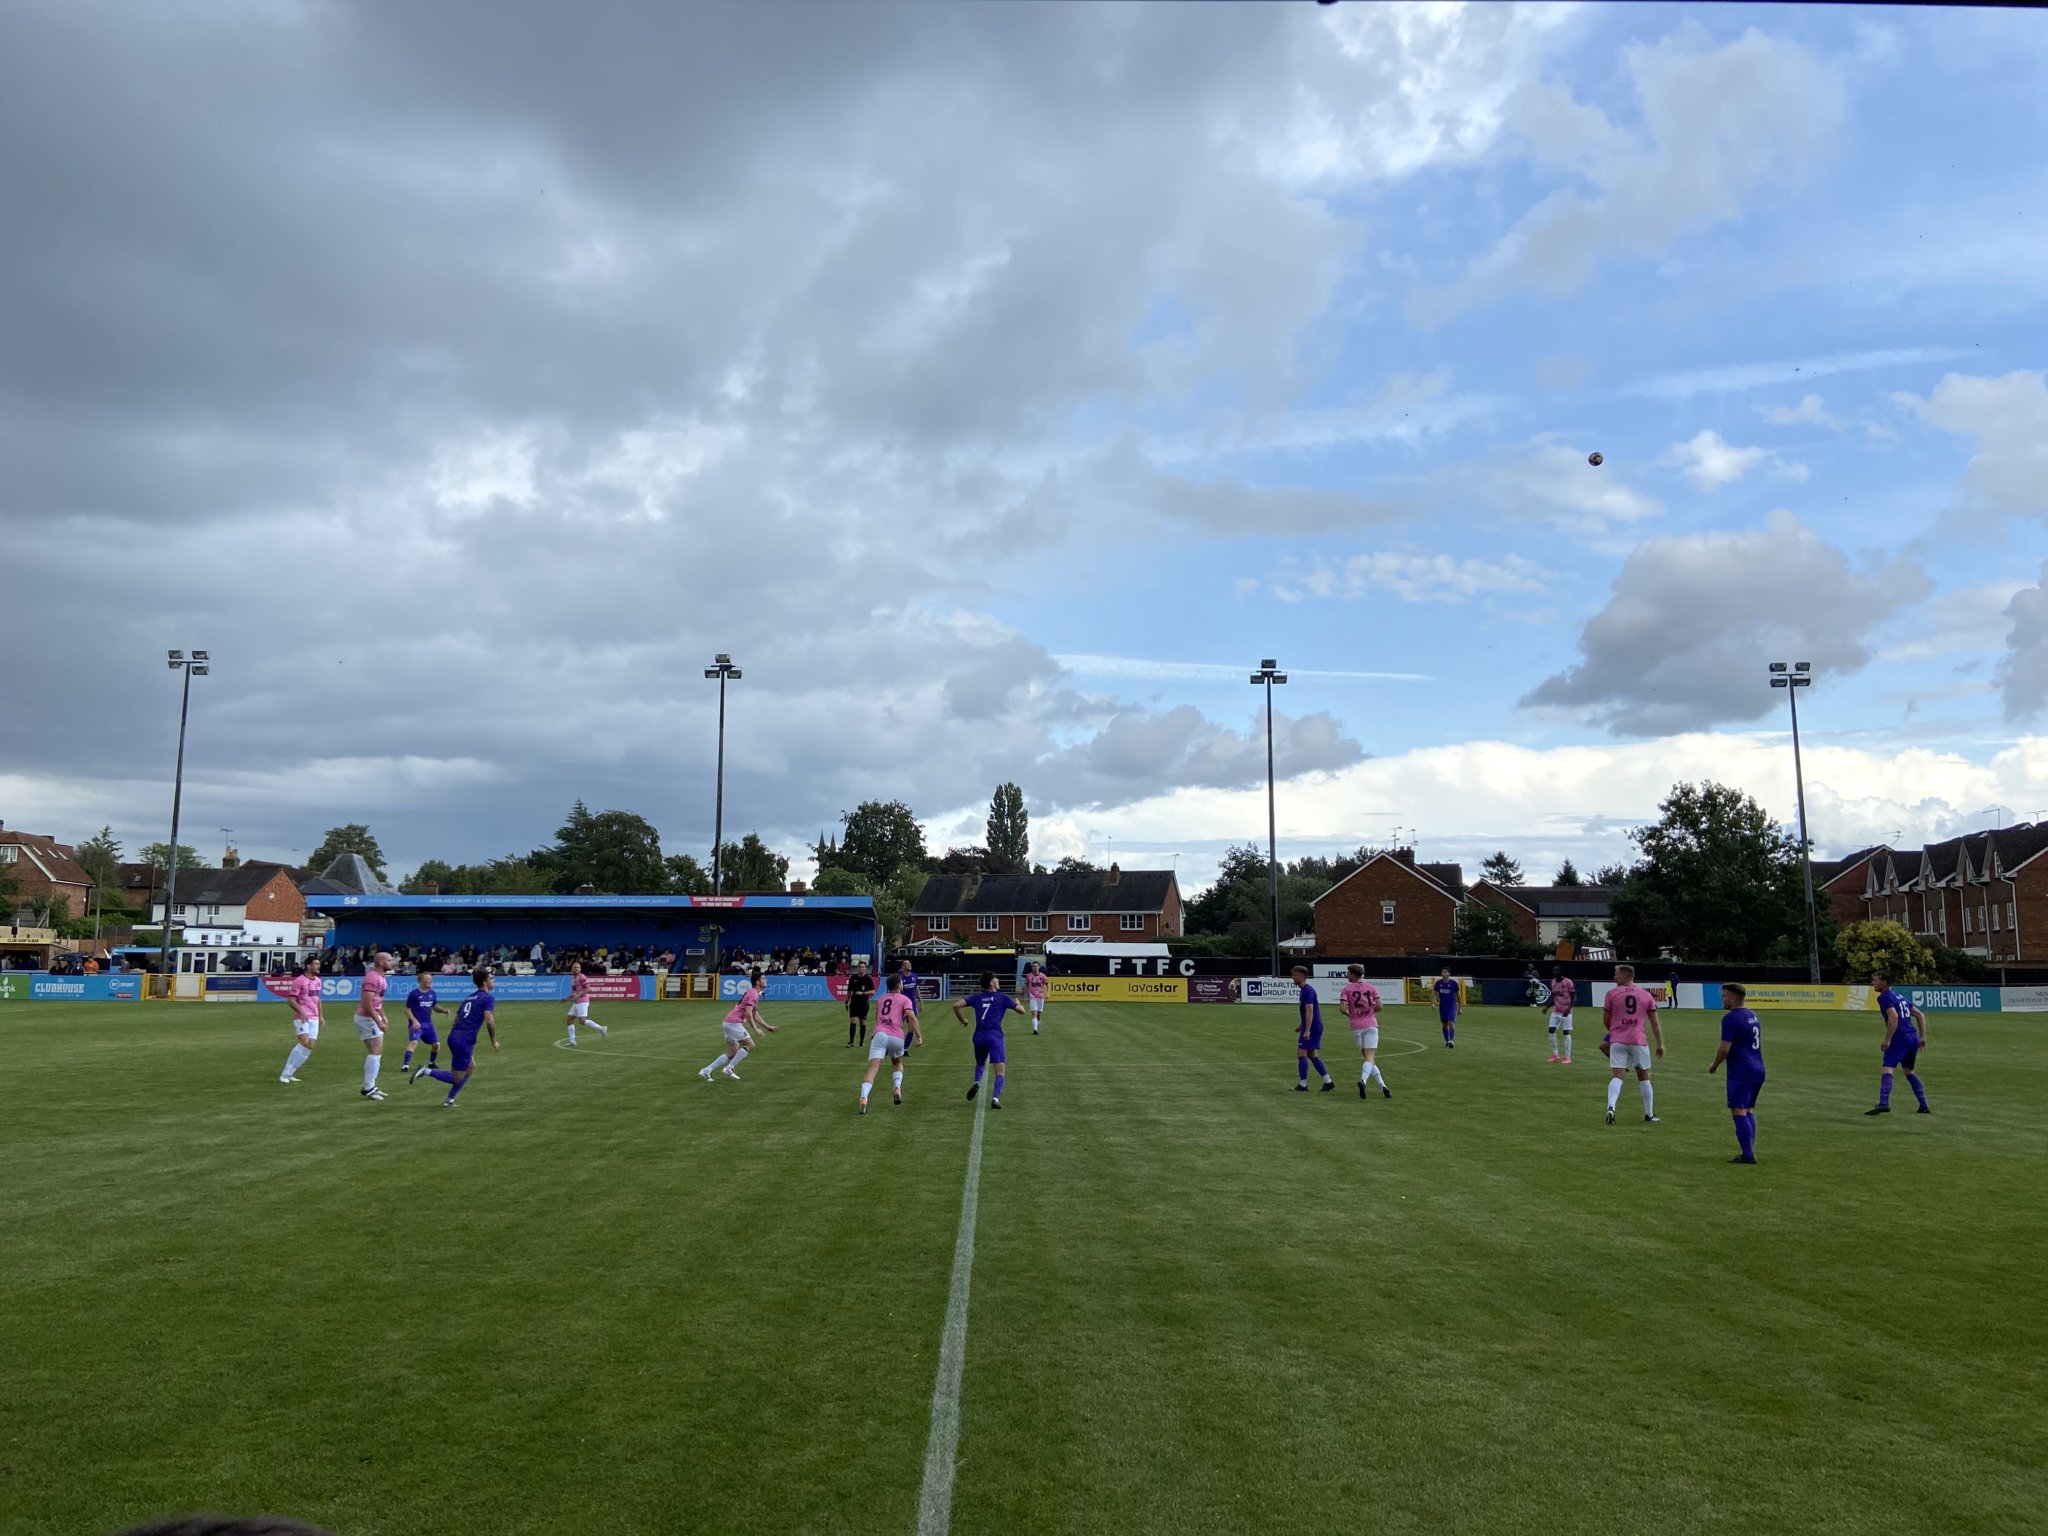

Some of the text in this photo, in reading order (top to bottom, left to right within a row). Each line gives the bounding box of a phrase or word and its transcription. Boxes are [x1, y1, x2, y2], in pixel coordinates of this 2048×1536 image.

[35, 983, 85, 993] CLUBHOUSE
[765, 979, 822, 995] arnham
[1051, 981, 1101, 992] lavastar
[1129, 982, 1179, 993] lavastar
[1248, 984, 1261, 993] CJ
[882, 999, 892, 1016] 8
[1352, 990, 1372, 1008] 21
[1625, 995, 1637, 1014] 9
[1926, 991, 1981, 1008] BREWDOG
[464, 1001, 472, 1018] 9
[981, 1003, 991, 1020] 7
[1899, 1001, 1911, 1018] 15
[1752, 1026, 1760, 1049] 3
